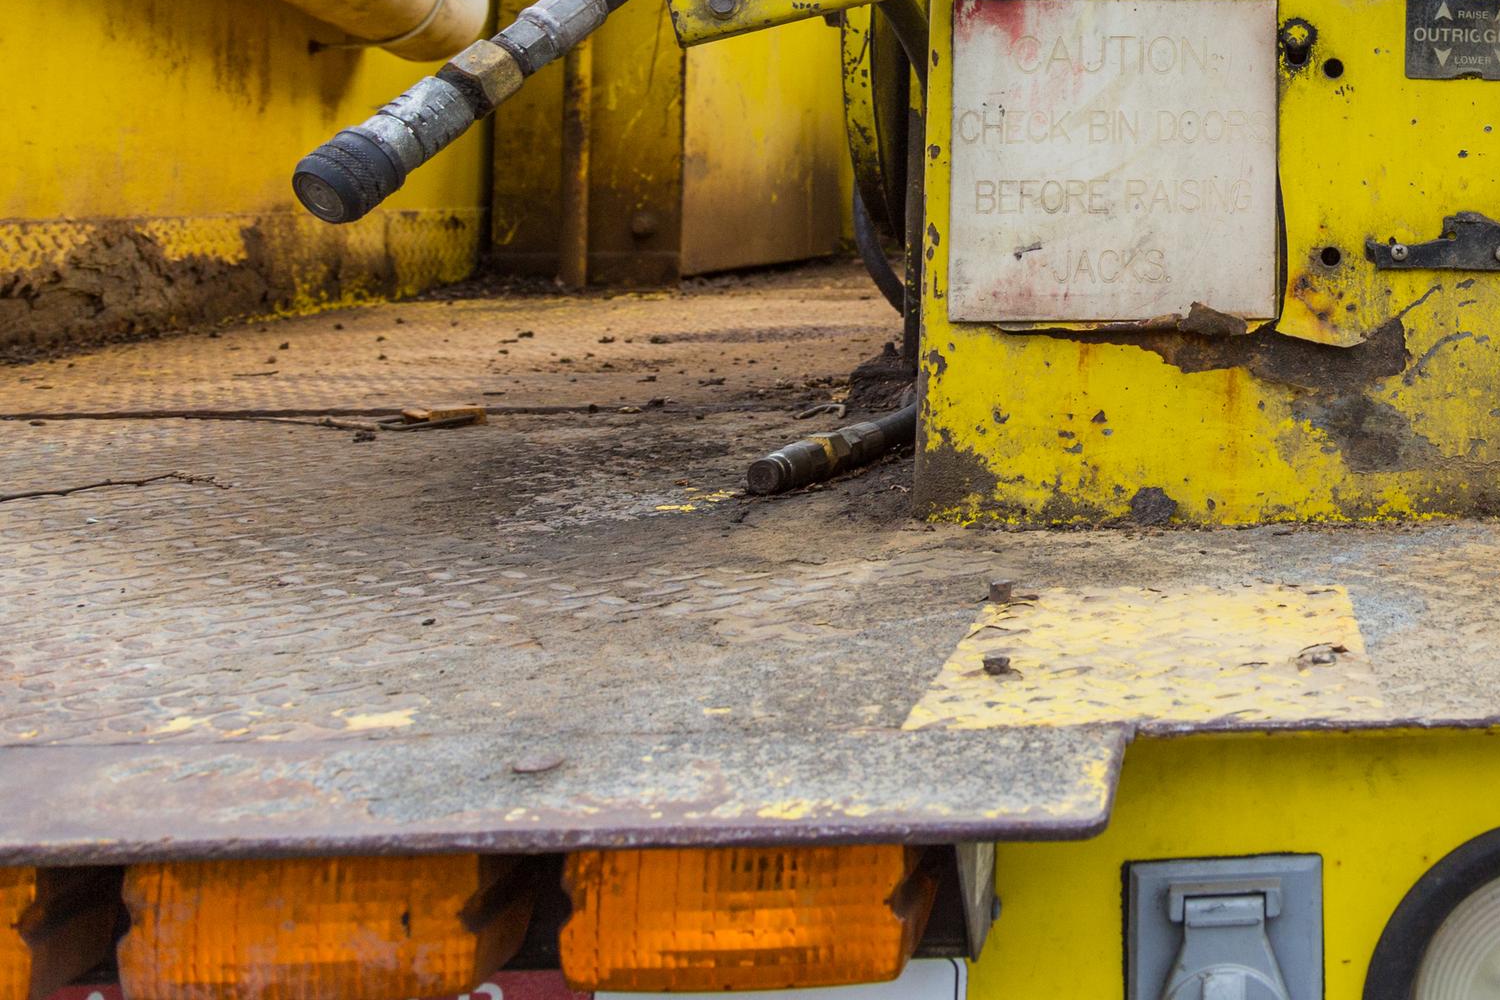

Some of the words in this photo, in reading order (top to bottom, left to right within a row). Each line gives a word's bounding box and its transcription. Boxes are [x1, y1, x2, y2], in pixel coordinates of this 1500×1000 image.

[1458, 11, 1489, 19] RAISE
[1454, 56, 1491, 65] LOWER
[958, 110, 1072, 144] CHECK
[1088, 111, 1139, 143] BIN
[1158, 110, 1269, 143] DOORS
[975, 179, 1109, 214] BEFORE
[1126, 179, 1252, 214] RAISING
[1053, 249, 1171, 284] JACKS.
